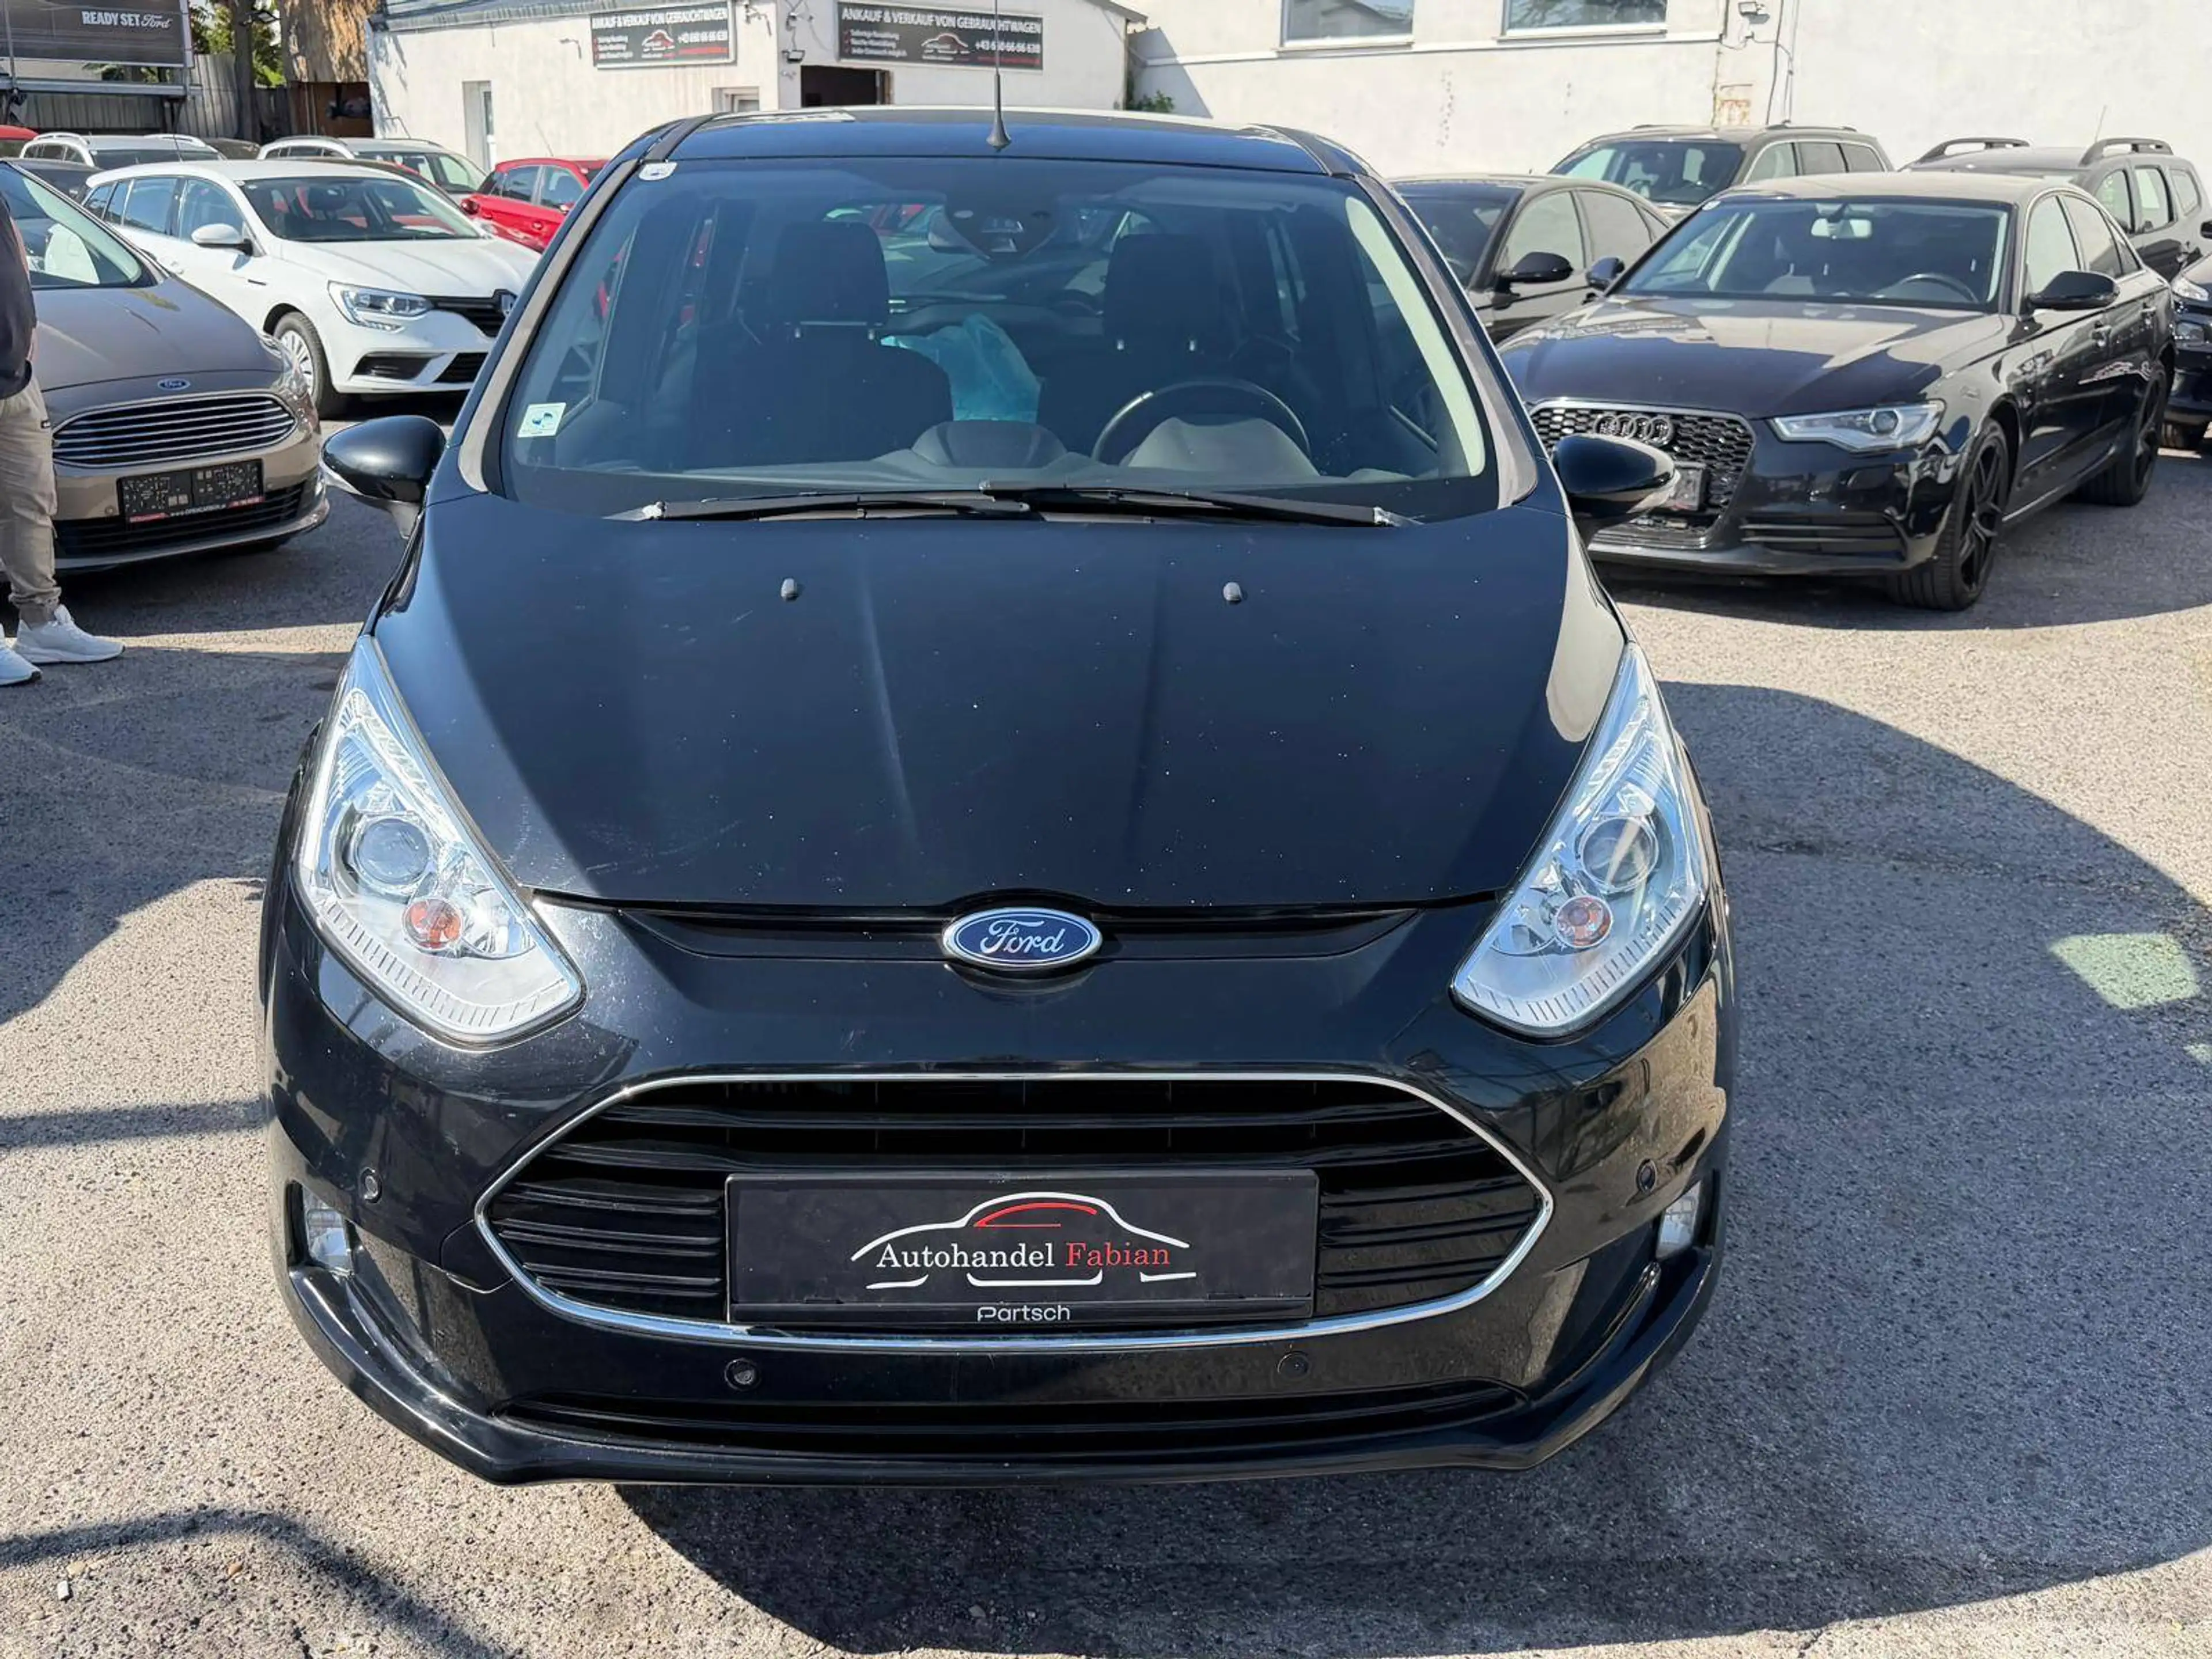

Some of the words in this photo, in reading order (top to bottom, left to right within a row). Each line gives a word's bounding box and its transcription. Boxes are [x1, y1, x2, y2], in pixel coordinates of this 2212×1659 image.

[82, 11, 118, 26] READY
[120, 13, 140, 26] SET
[141, 14, 173, 29] Ford
[980, 919, 1065, 954] Ford
[876, 1242, 1055, 1268] Autohandel
[1066, 1241, 1170, 1267] Fabian
[977, 1304, 1070, 1323] Partsch
